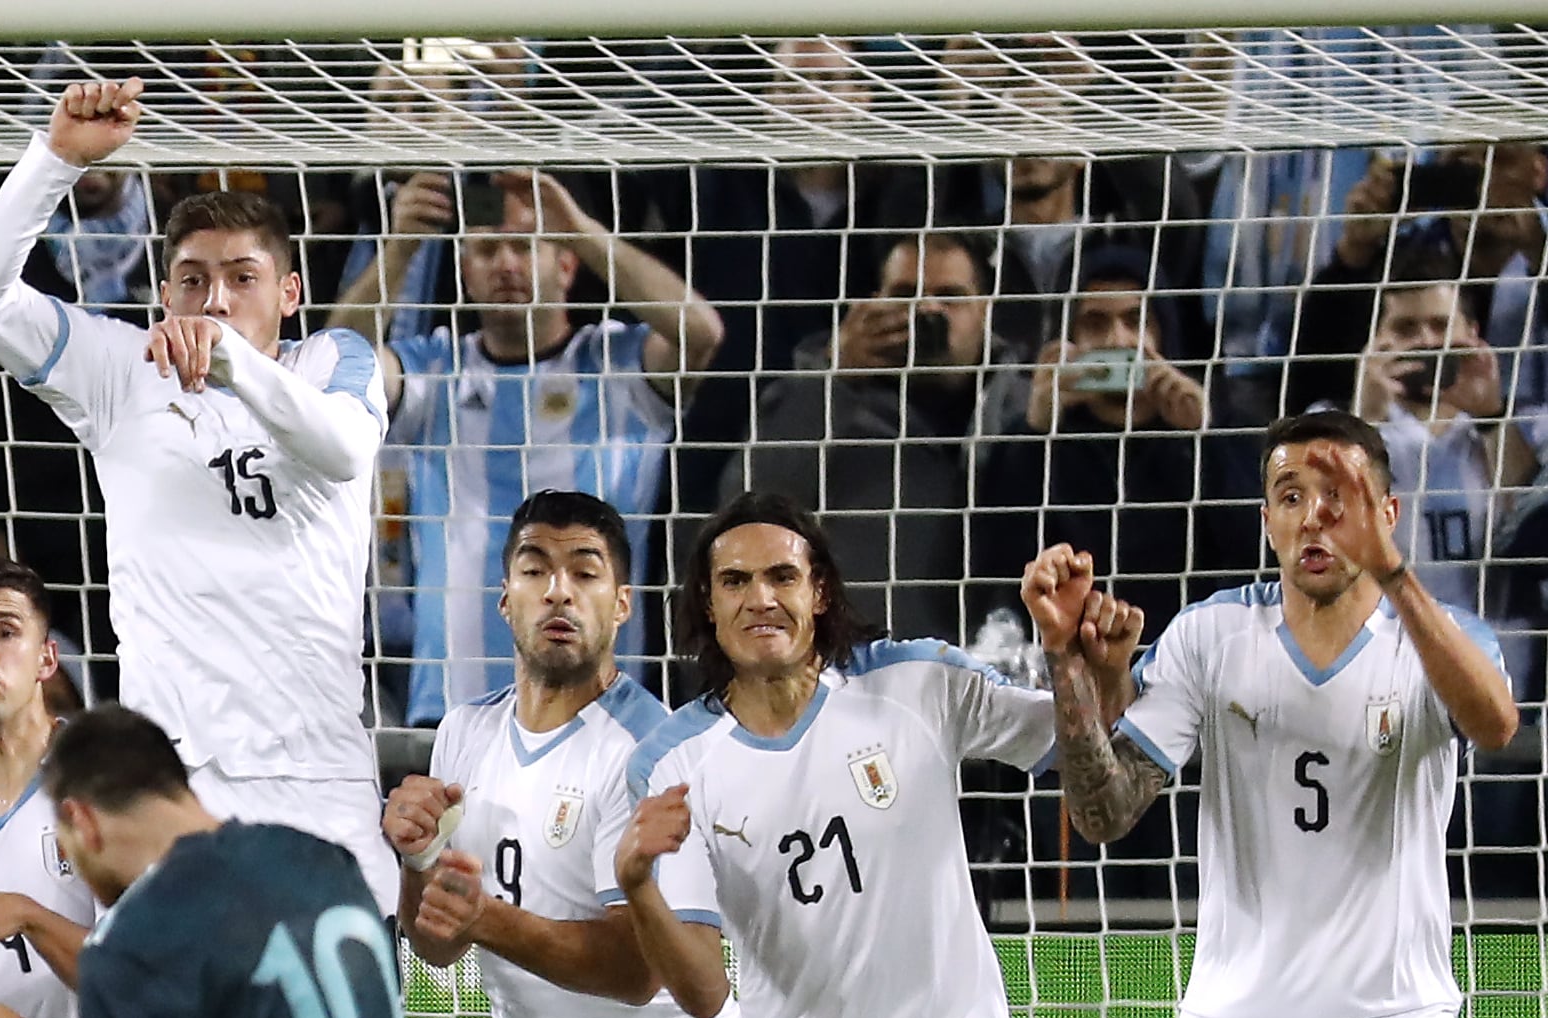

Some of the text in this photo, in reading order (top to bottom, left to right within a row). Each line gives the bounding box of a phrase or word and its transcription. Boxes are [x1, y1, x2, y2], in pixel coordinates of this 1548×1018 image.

[207, 447, 278, 520] 15
[1425, 510, 1470, 562] 10
[1294, 751, 1330, 833] 5
[495, 837, 522, 908] 9
[778, 815, 863, 905] 21
